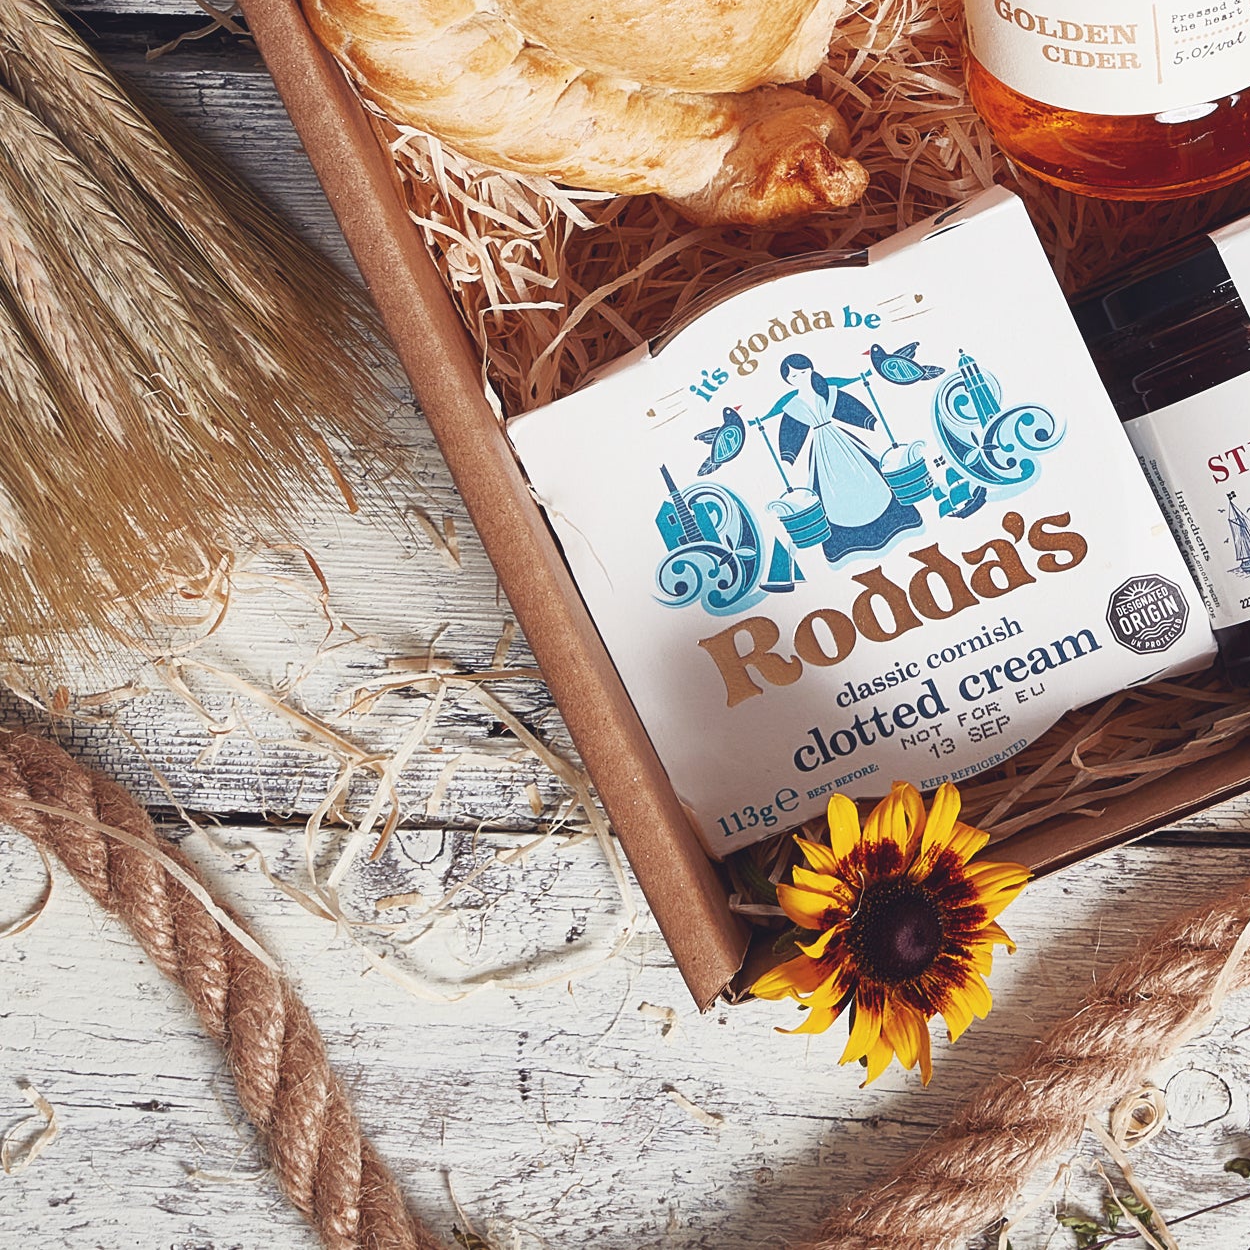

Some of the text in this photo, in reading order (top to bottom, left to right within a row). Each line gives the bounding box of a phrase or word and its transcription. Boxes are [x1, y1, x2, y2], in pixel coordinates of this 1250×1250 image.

[1171, 2, 1227, 24] Pressed
[1173, 23, 1196, 34] the
[1205, 8, 1243, 26] heart
[1042, 45, 1142, 70] CIDER
[689, 305, 881, 403] it's godda be
[1174, 491, 1212, 562] Ingredients
[697, 511, 1089, 709] Rodda's
[1115, 586, 1169, 617] DESIGNATED
[1119, 594, 1179, 635] ORIGIN
[1130, 618, 1183, 648] UK PROTECTED
[836, 617, 1024, 709] classic cornish
[793, 628, 1102, 773] clotted cream
[900, 723, 944, 750] NOT
[957, 702, 1001, 727] FOR
[929, 715, 1011, 759] 13 SEP
[807, 764, 880, 800] BEST BEFORE:
[921, 738, 1028, 790] KEEP REFRIGERATED
